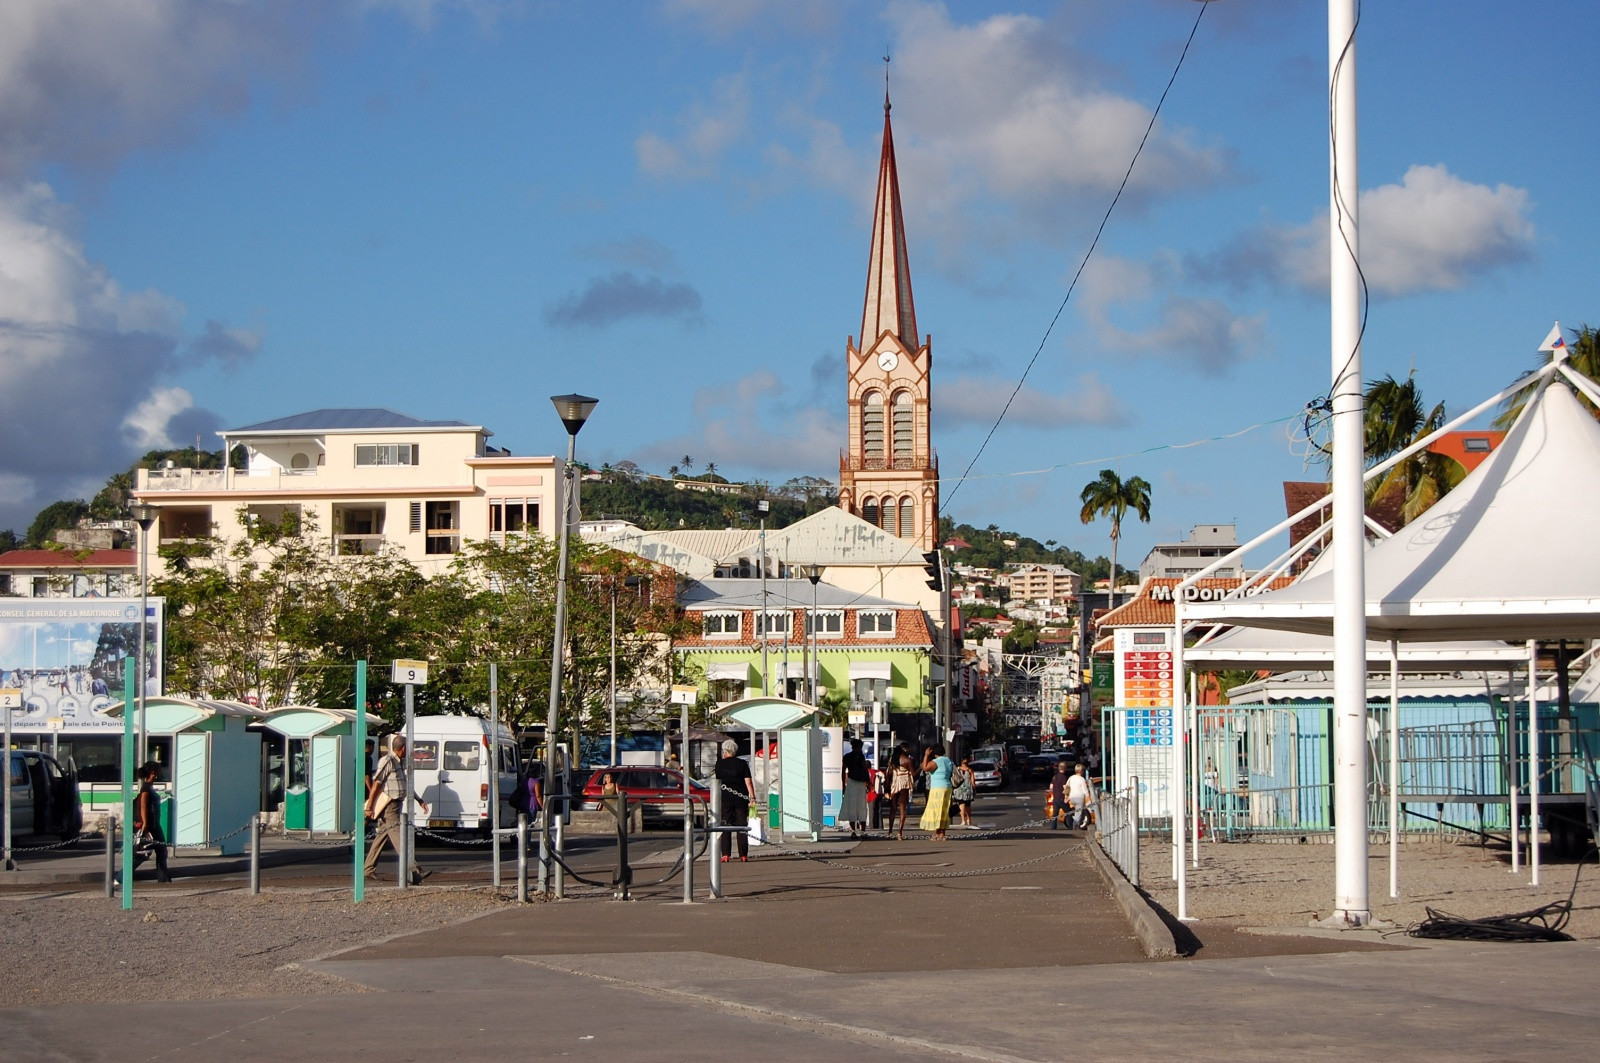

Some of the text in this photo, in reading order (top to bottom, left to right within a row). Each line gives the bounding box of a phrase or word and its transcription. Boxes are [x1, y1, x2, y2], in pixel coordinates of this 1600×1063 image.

[408, 670, 415, 680] 9
[962, 666, 970, 698] Bata
[5, 696, 11, 704] 2
